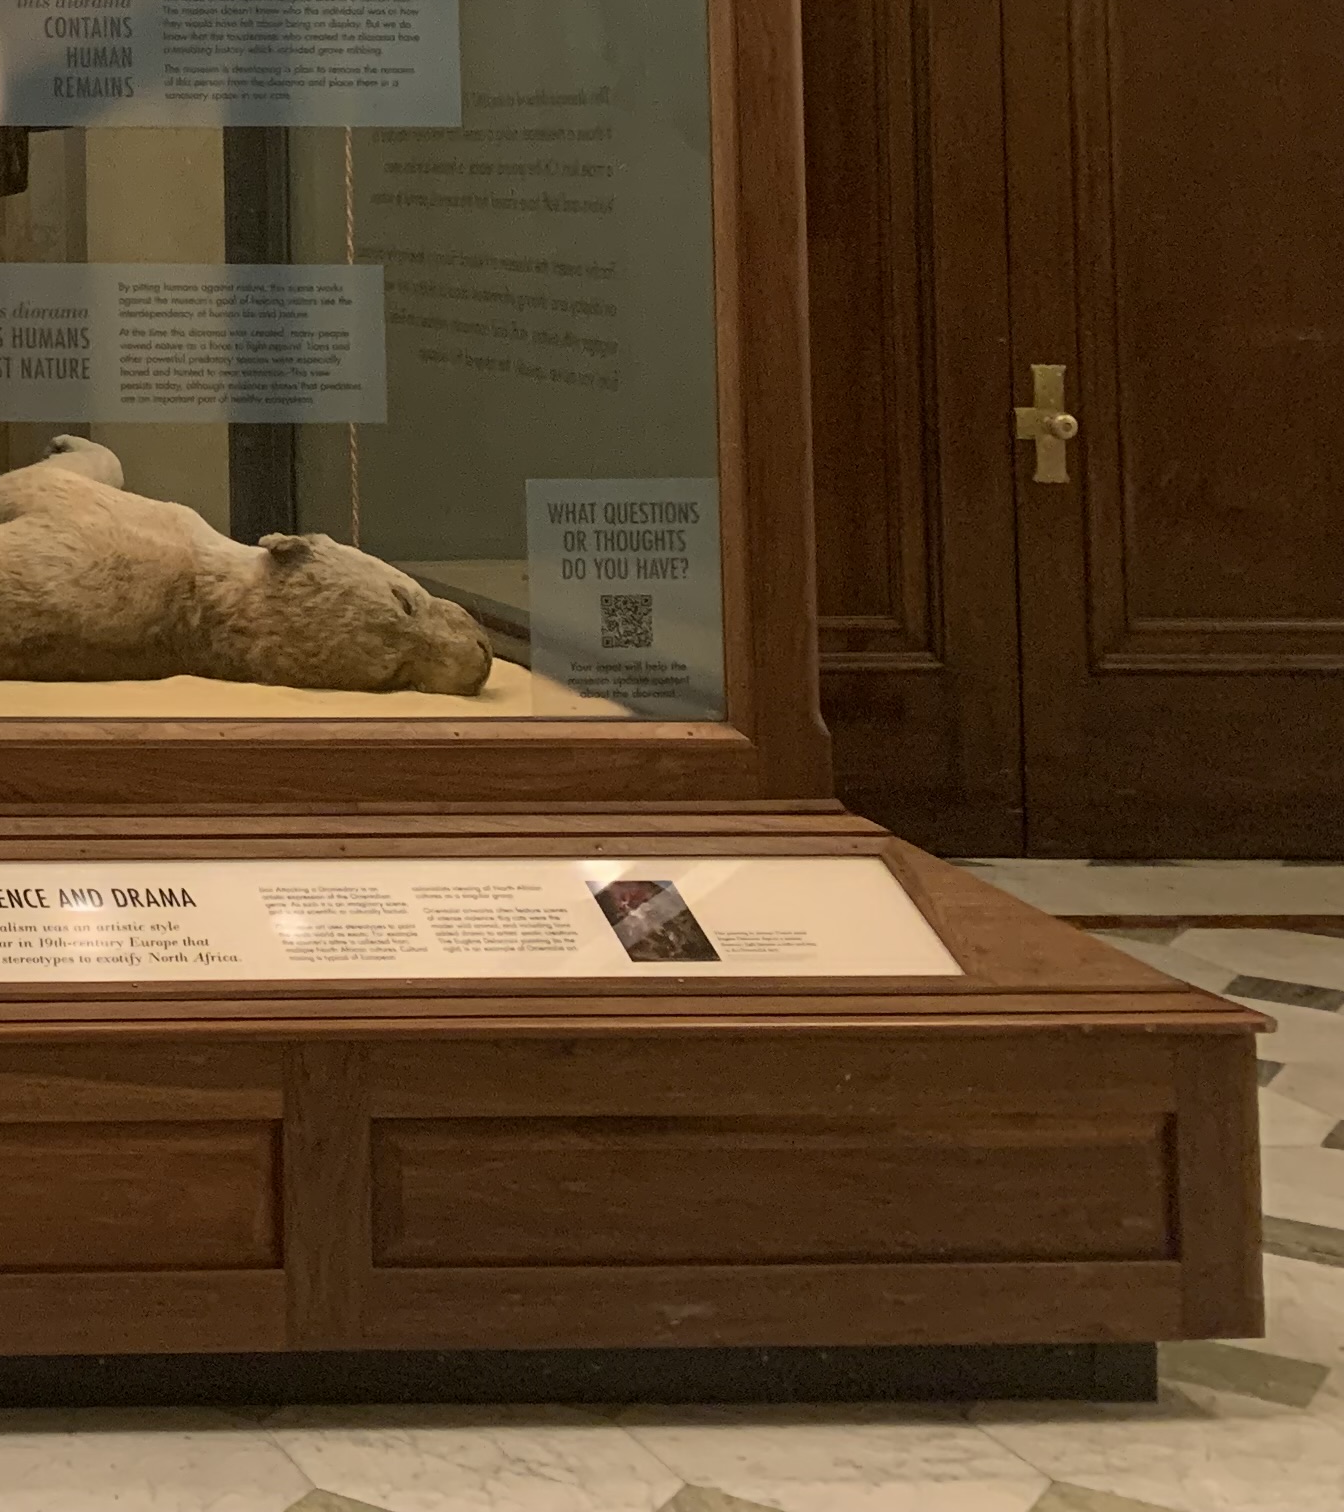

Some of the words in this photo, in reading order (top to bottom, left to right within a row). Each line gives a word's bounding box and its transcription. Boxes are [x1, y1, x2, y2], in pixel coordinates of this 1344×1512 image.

[43, 15, 132, 39] CONTAINS
[65, 45, 133, 68] HUMAN
[52, 75, 134, 99] REMAINS
[10, 300, 89, 319] diorama
[11, 326, 90, 349] HUMANS
[20, 356, 90, 380] NATURE
[546, 501, 596, 524] WHAT
[602, 501, 700, 526] QUESTIONS
[562, 529, 587, 552] OR
[592, 528, 686, 552] THOUGHTS
[561, 557, 586, 580] DO
[592, 556, 629, 580] YOU
[635, 556, 688, 580] HAVE?
[58, 888, 103, 908] AND
[110, 887, 196, 907] DRAMA
[149, 921, 179, 931] style
[18, 940, 32, 948] in
[39, 937, 122, 948] 19th-century
[129, 936, 178, 950] Europe
[182, 936, 209, 946] that
[2, 955, 75, 967] stereotypes
[95, 952, 141, 966] exotify
[148, 952, 188, 962] North
[193, 952, 241, 965] Africa.
